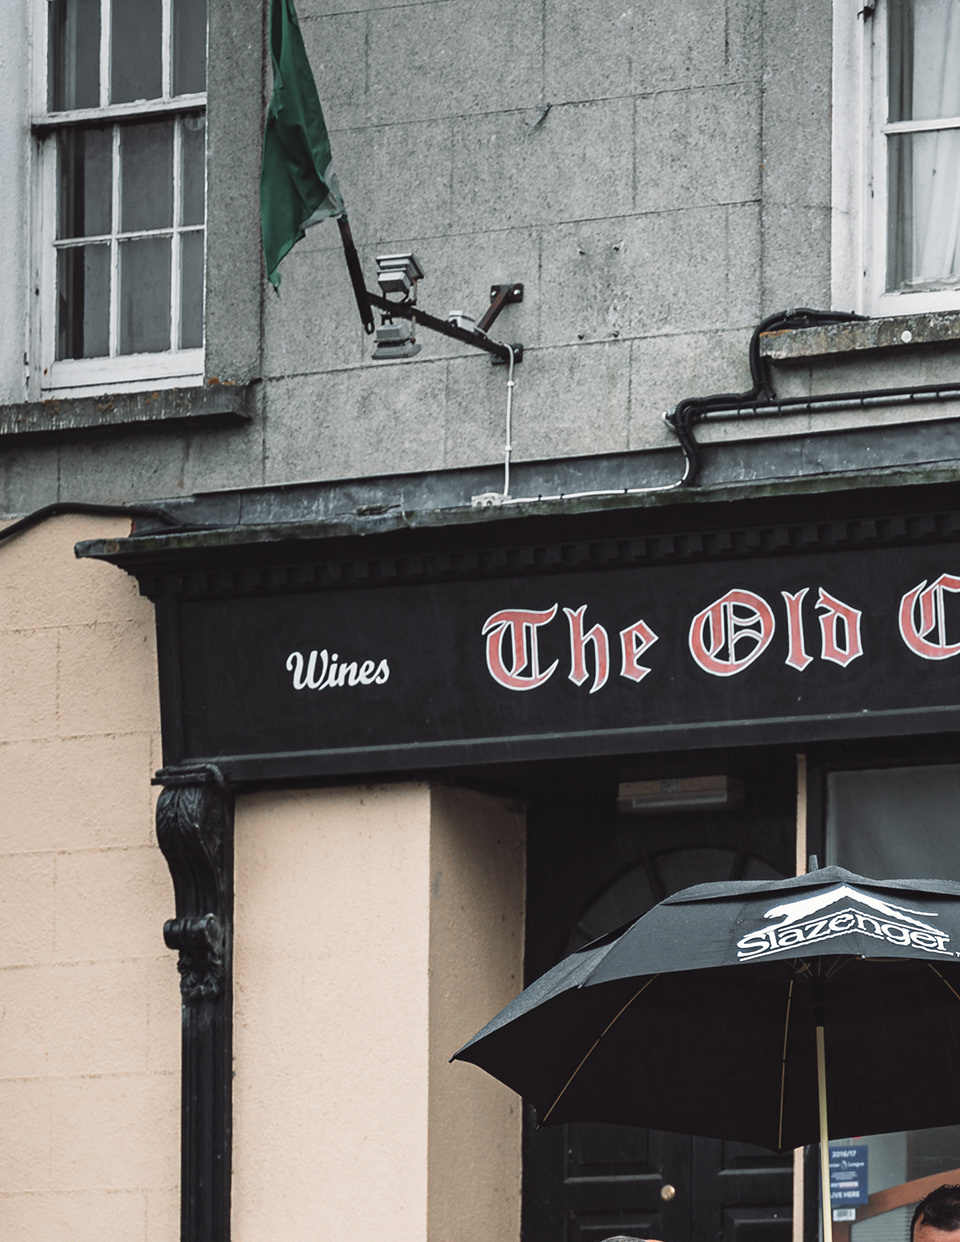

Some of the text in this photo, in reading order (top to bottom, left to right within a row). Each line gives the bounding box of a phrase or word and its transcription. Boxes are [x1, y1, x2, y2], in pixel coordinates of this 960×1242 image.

[481, 603, 658, 693] The
[688, 588, 864, 677] Old
[286, 649, 390, 690] Wines
[737, 913, 950, 957] Slazenger
